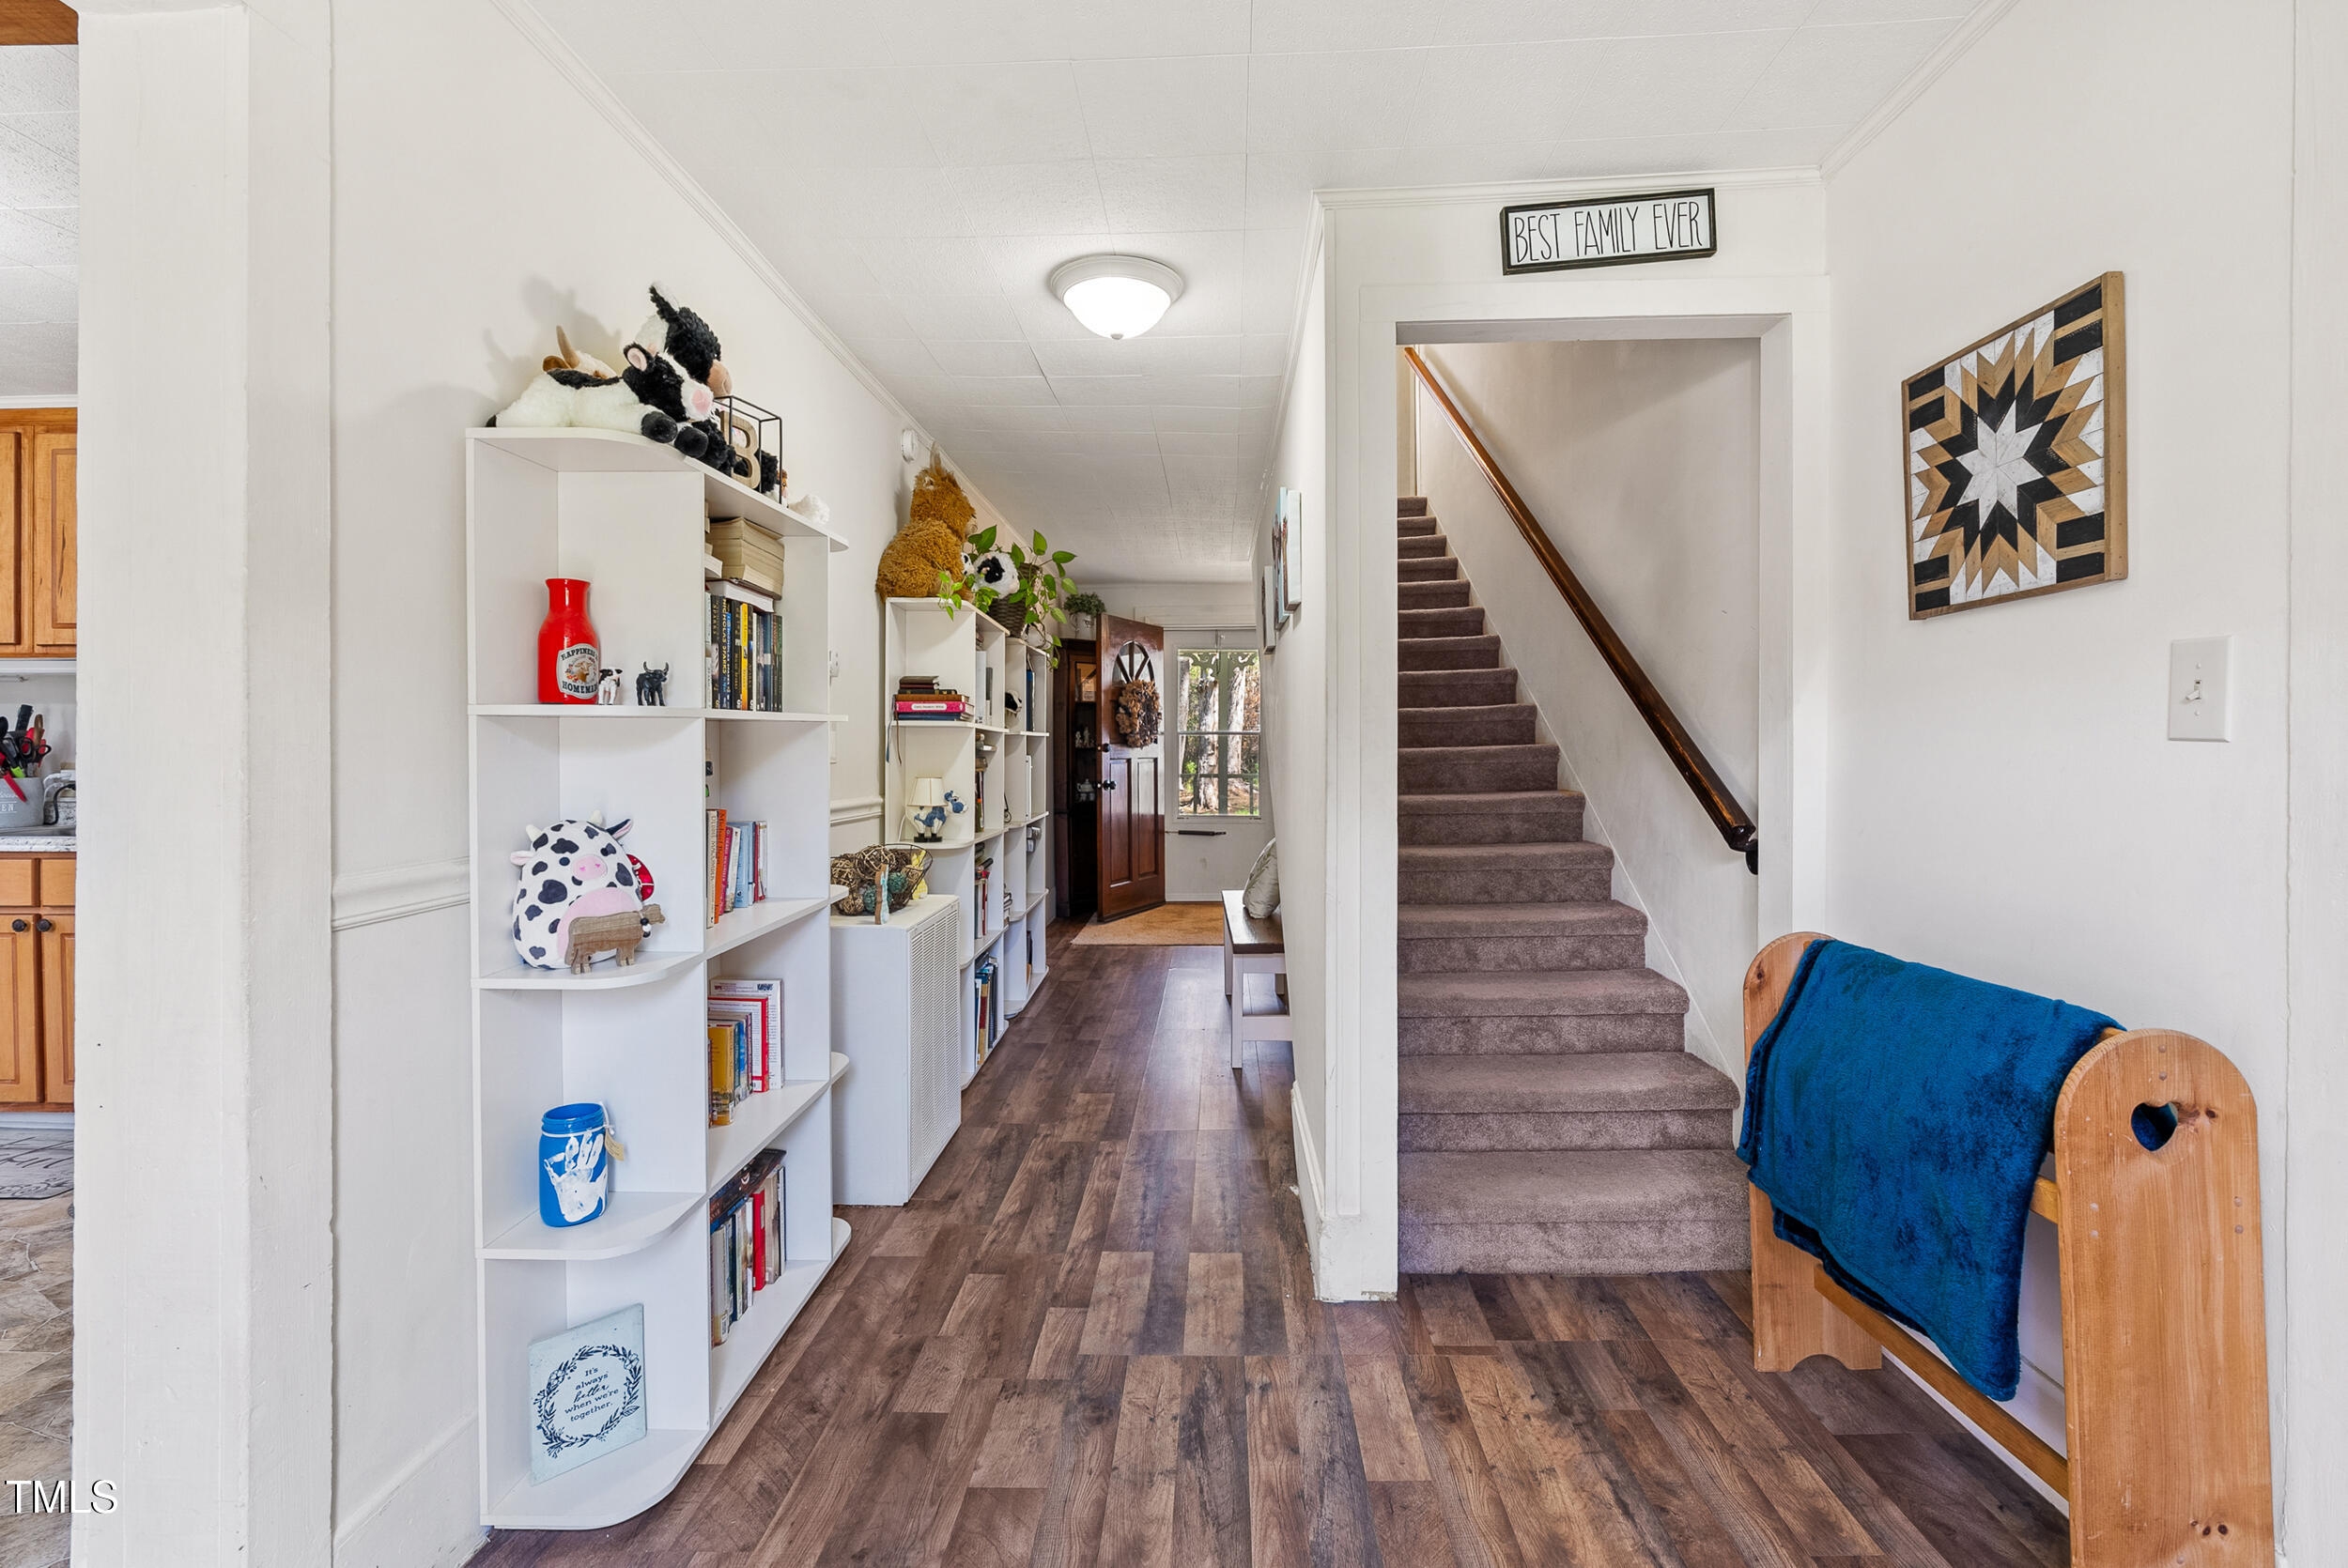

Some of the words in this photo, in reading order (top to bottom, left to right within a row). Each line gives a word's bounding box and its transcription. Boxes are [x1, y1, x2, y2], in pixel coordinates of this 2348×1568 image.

[1514, 212, 1560, 263] BEST
[1574, 206, 1639, 257] FAMILY
[1653, 201, 1703, 251] EVER
[720, 410, 761, 489] B
[585, 1368, 598, 1376] It's
[576, 1374, 609, 1391] always
[564, 1400, 592, 1414] when
[595, 1390, 619, 1402] we're
[574, 1384, 610, 1403] better
[570, 1402, 613, 1422] together.
